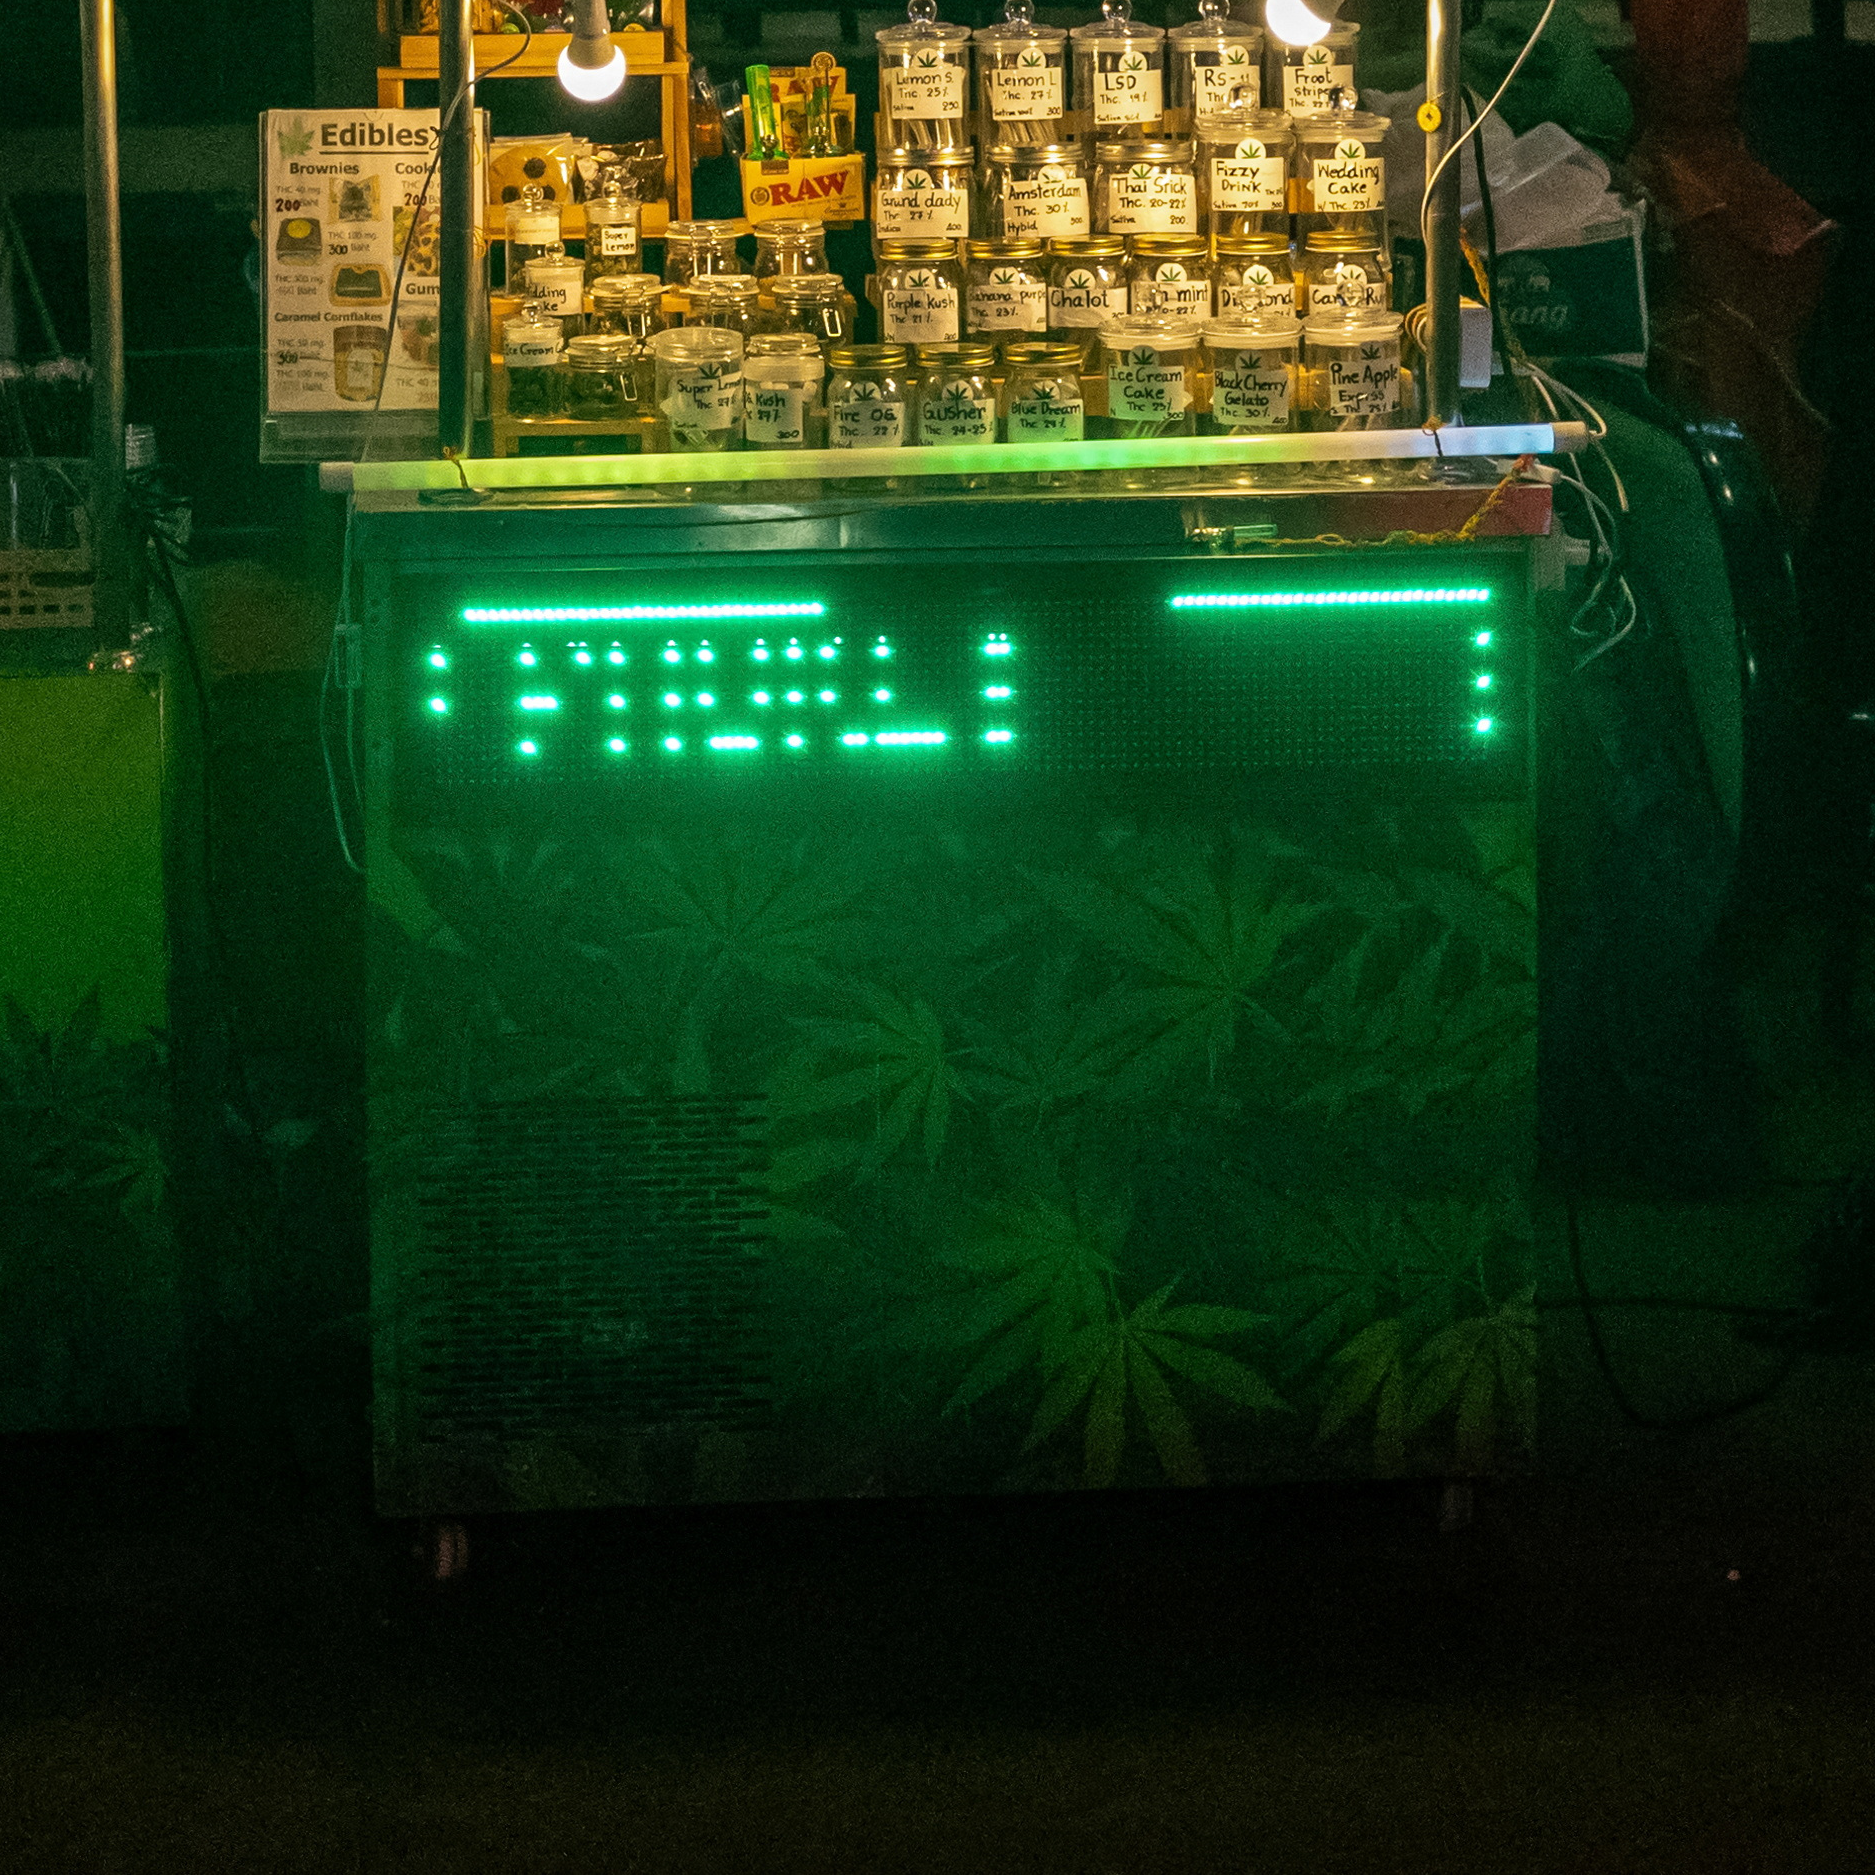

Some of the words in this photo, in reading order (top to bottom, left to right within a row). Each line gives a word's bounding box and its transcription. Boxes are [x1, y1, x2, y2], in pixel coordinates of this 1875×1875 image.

[895, 72, 943, 86] Lemon
[996, 72, 1046, 87] Lemon
[1104, 73, 1137, 91] LSD
[1294, 67, 1333, 85] Froot
[320, 123, 430, 147] Edibles
[289, 162, 360, 175] Brownies
[1215, 160, 1260, 180] Fizzy
[1317, 162, 1380, 185] Wedding
[768, 170, 850, 207] RAW
[1007, 185, 1082, 201] Amsterdam
[1111, 177, 1148, 194] Thai
[1221, 178, 1262, 194] Drink
[1327, 182, 1367, 195] Cake
[275, 198, 301, 213] 200
[924, 192, 962, 214] dady
[885, 292, 922, 315] Purple
[1050, 289, 1110, 309] Chalot
[274, 312, 321, 323] Caramel
[323, 311, 384, 323] Cornflakes
[1109, 365, 1134, 381] Ice
[1135, 366, 1183, 382] Cream
[1331, 365, 1359, 386] Pine
[676, 379, 713, 402] Super
[1124, 387, 1165, 401] Cake
[1243, 374, 1288, 397] Cherry
[1224, 392, 1270, 407] Gelato
[923, 401, 986, 420] Gusher
[1011, 402, 1037, 415] Blue
[1040, 402, 1081, 415] Dream
